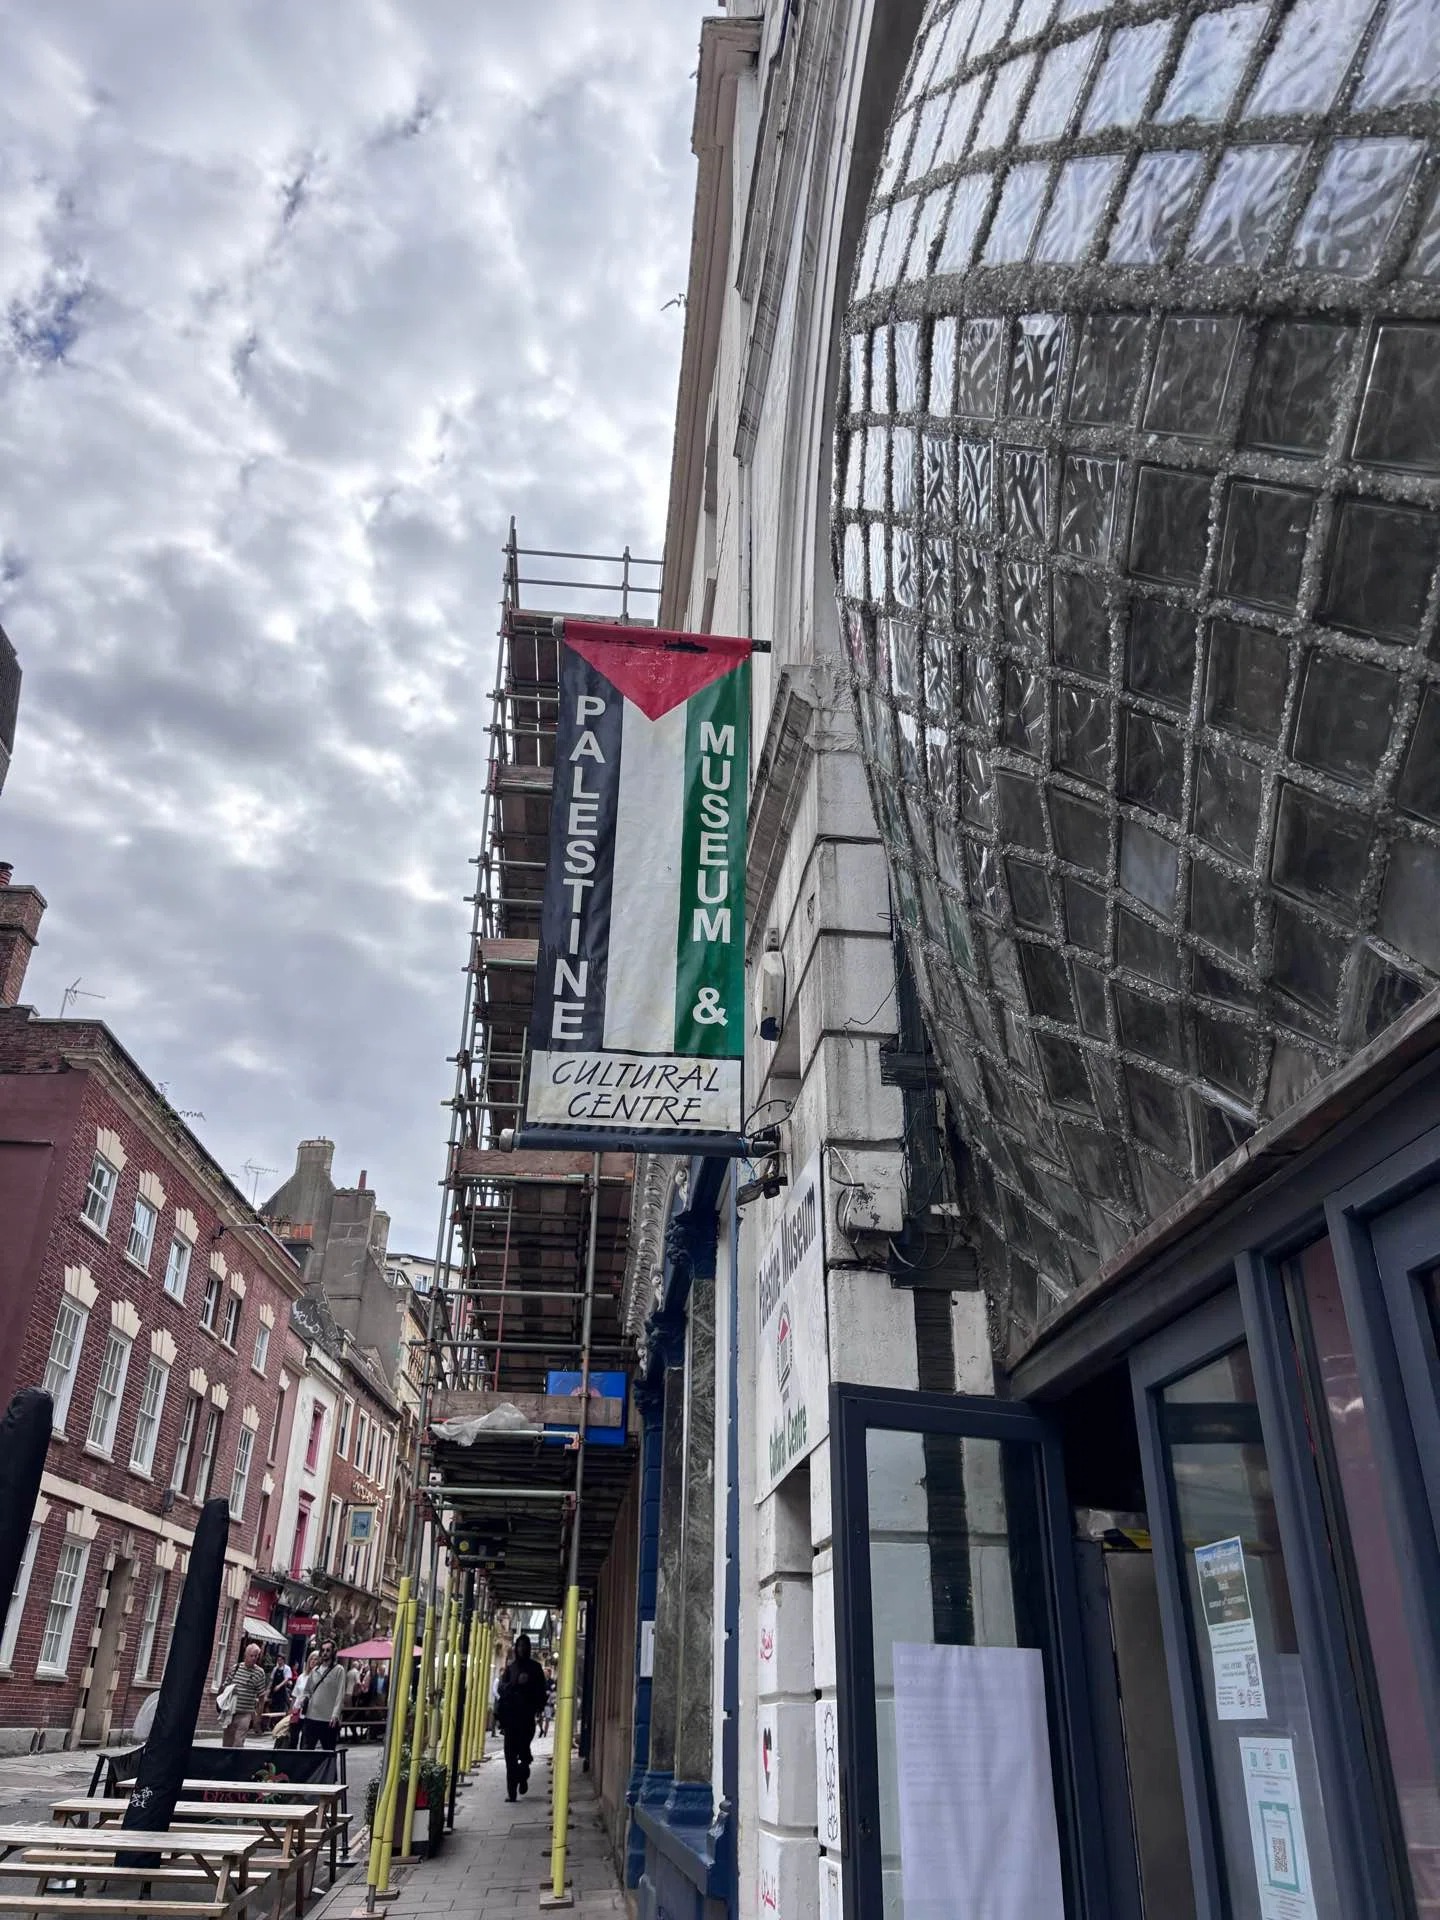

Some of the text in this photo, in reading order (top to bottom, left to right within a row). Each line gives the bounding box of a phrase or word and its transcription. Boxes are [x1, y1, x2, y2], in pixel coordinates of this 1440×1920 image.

[551, 695, 606, 1040] PALESTINE
[692, 721, 735, 1027] MUSEUM &
[552, 1059, 720, 1093] CULTURAL
[568, 1091, 702, 1125] CENTRE
[781, 1182, 816, 1288] Museum
[787, 1400, 807, 1459] Centre
